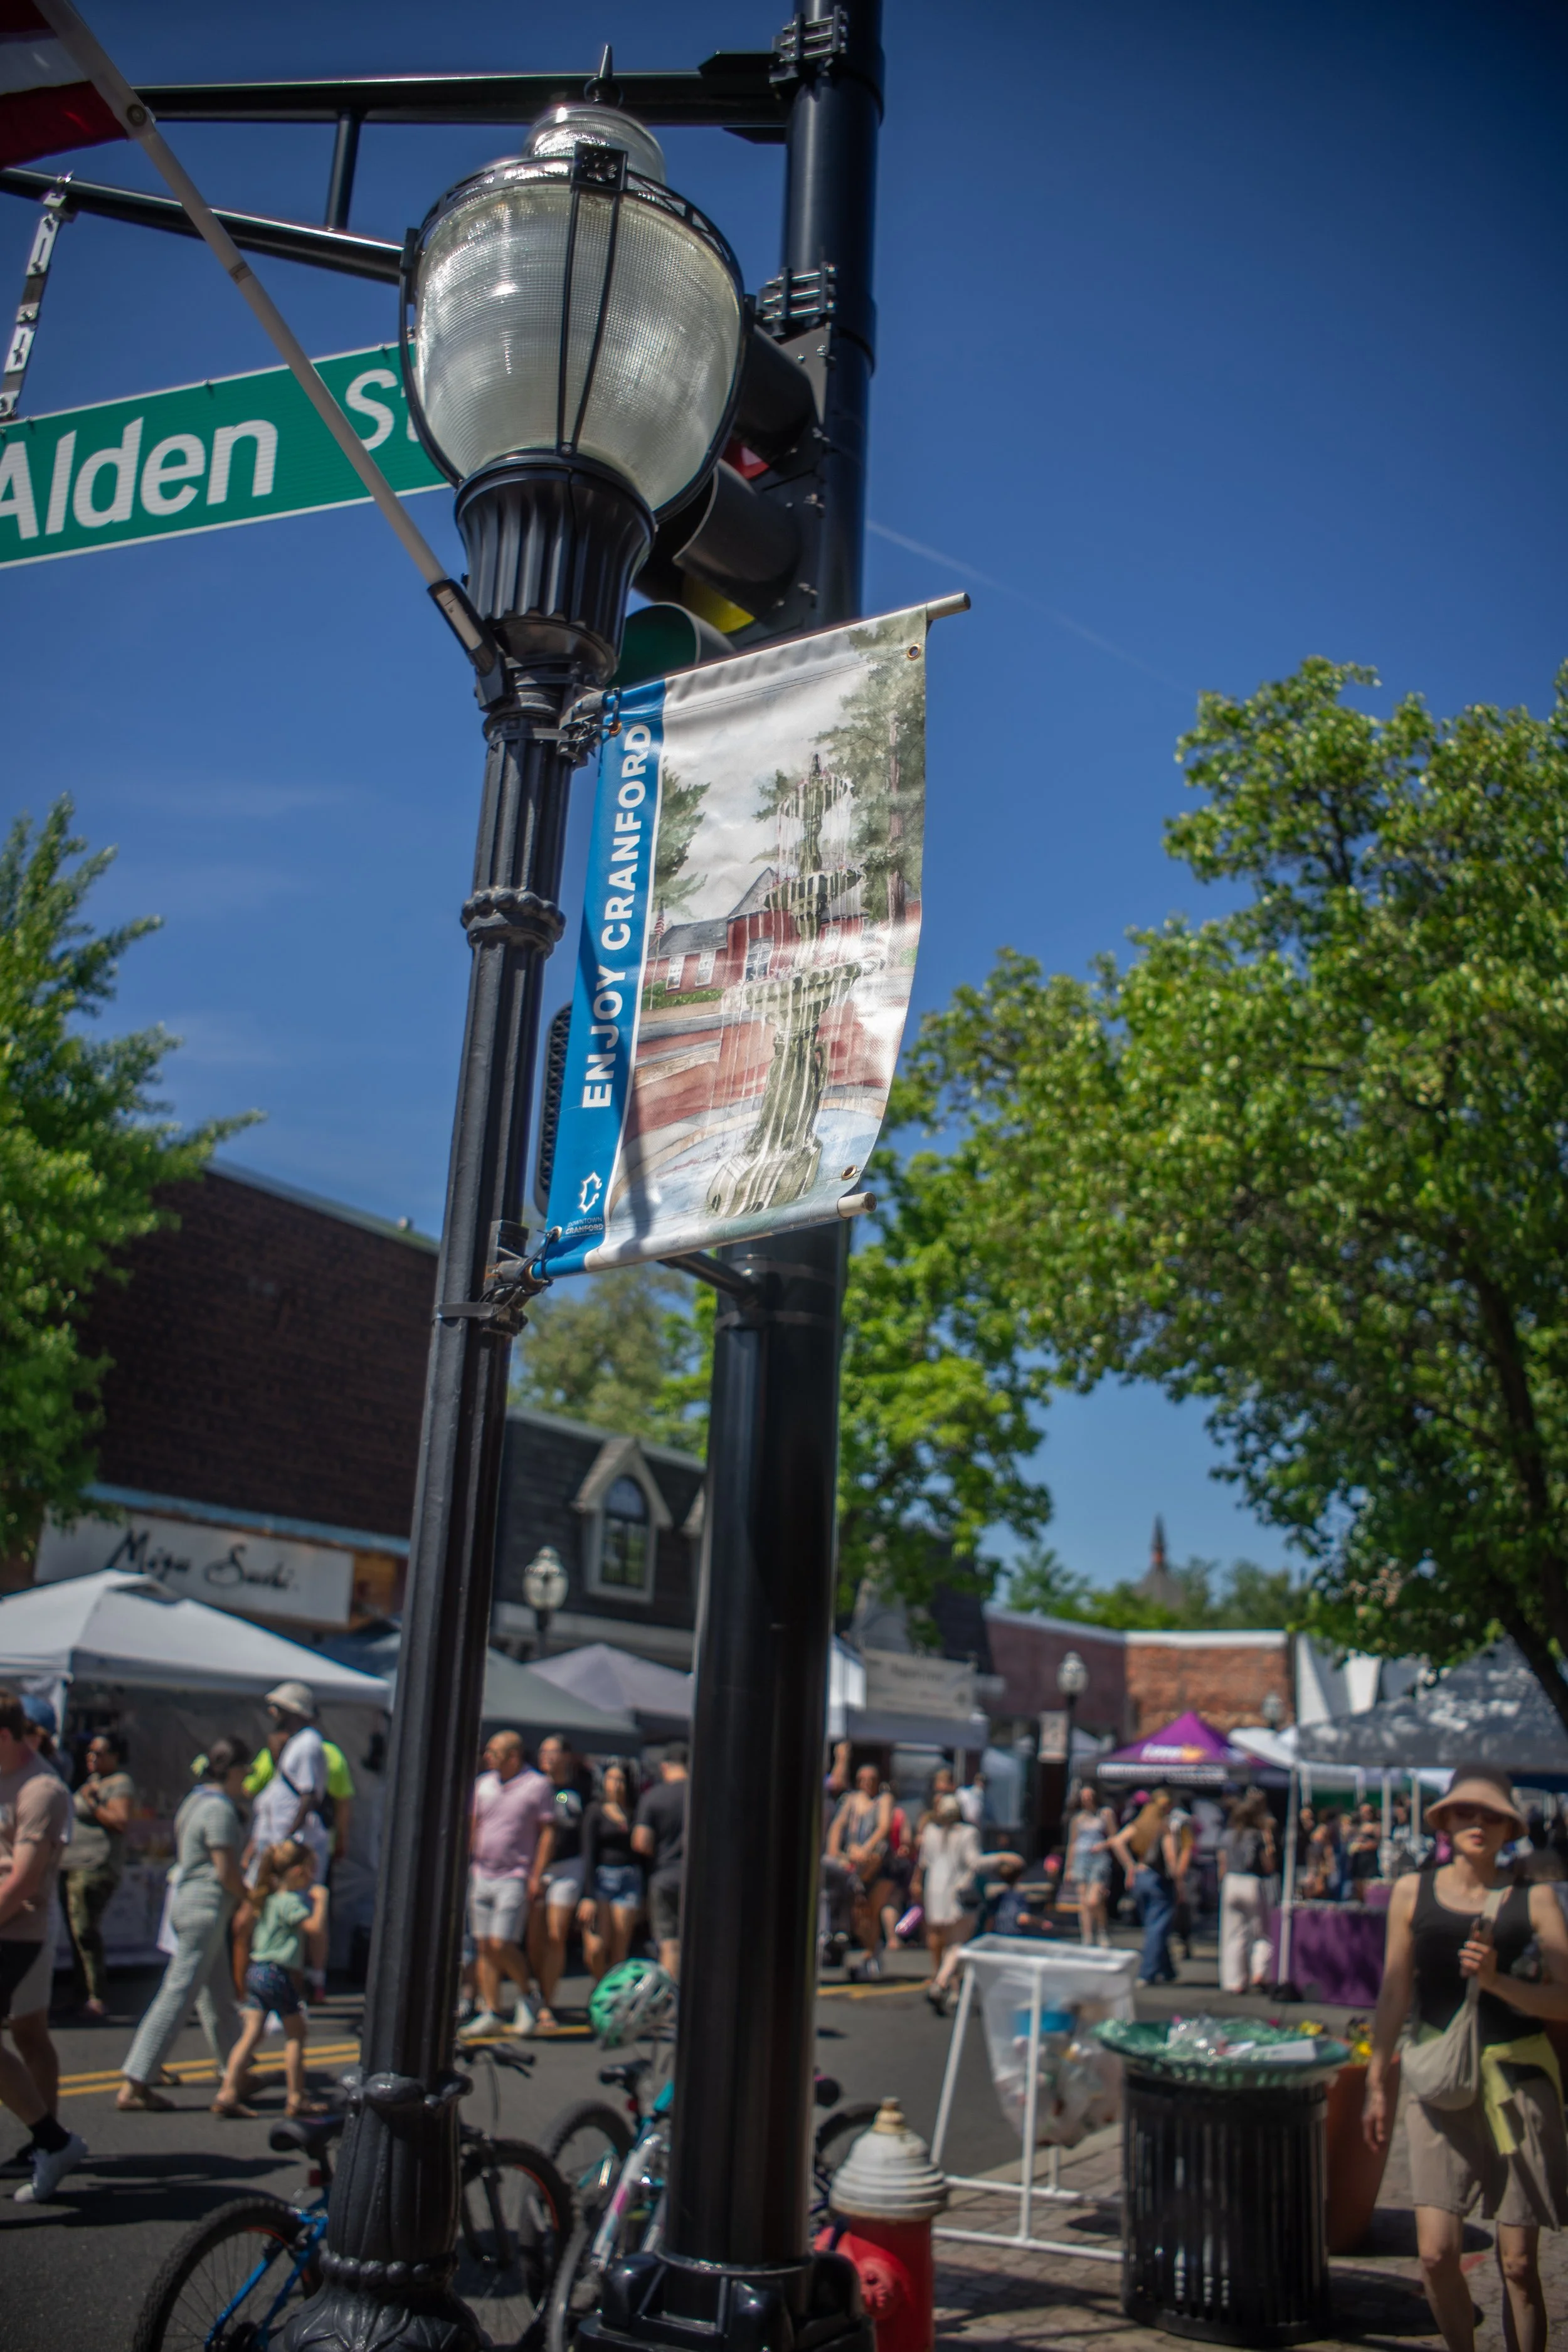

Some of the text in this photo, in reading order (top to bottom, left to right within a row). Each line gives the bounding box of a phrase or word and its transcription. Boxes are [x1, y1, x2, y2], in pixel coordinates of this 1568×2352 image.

[0, 417, 278, 540] Alden
[582, 724, 652, 1108] ENJOY CRANFORD
[566, 1224, 603, 1235] CRANFORD
[568, 1217, 602, 1227] DOWNTOWN
